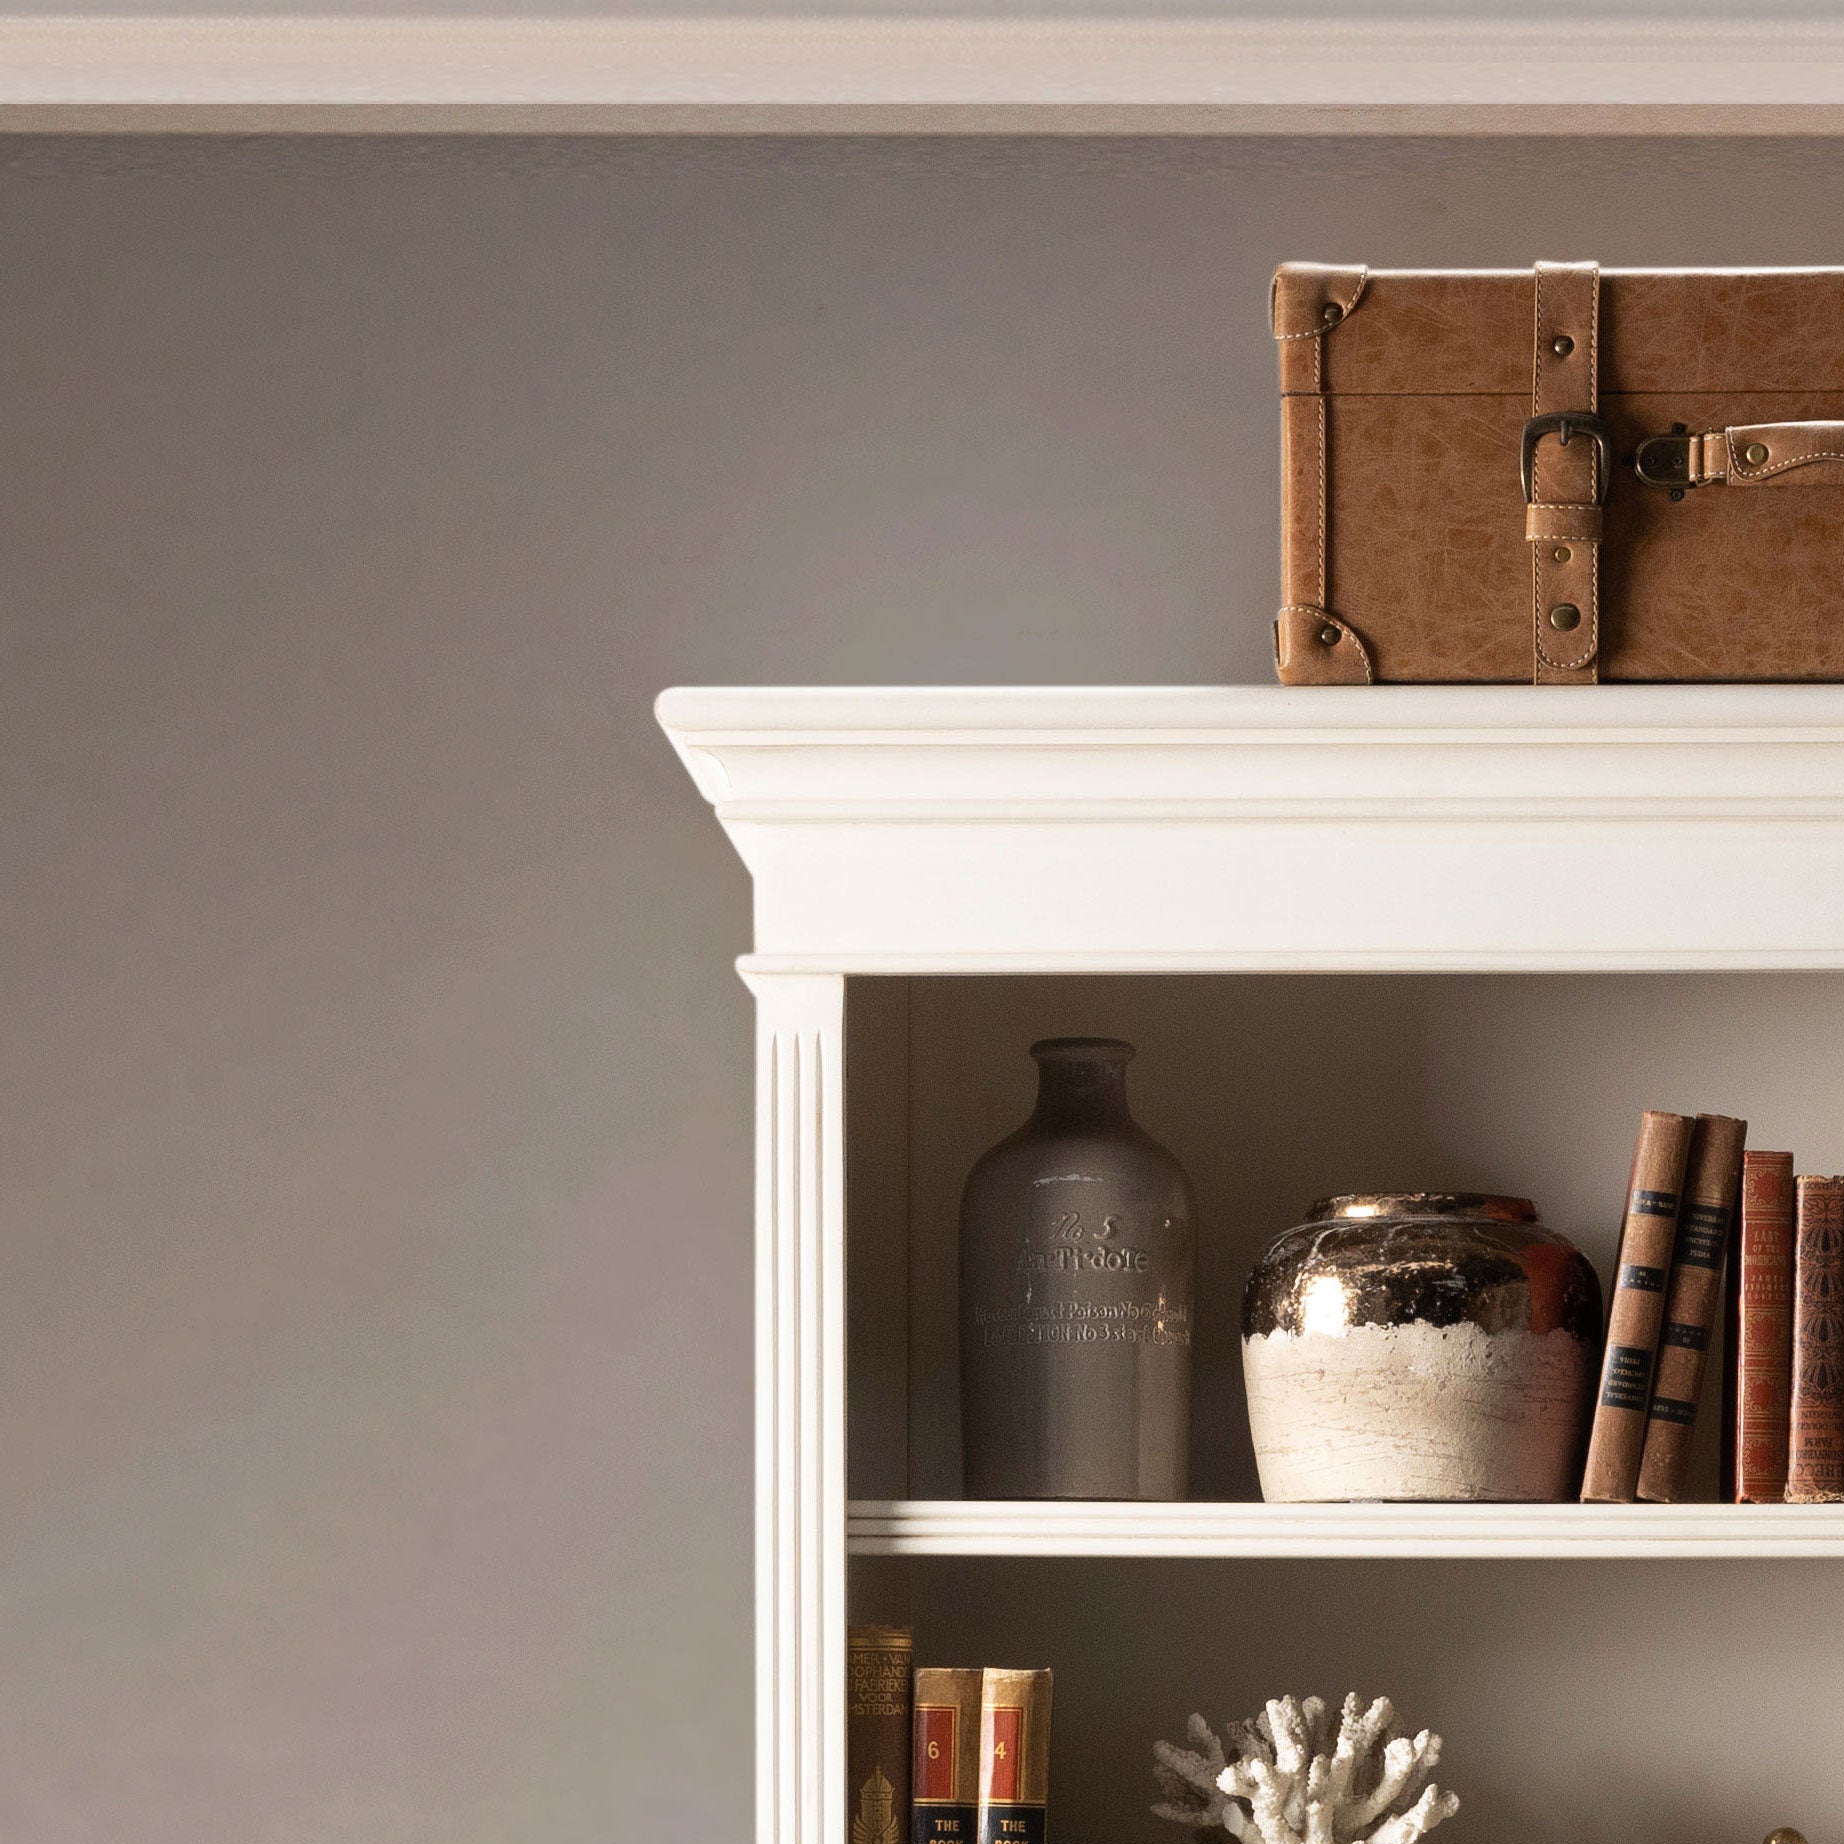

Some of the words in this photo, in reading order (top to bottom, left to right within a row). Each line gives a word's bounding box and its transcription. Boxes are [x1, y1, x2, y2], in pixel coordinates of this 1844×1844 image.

[928, 1741, 940, 1759] 6
[995, 1741, 1007, 1760] 4
[934, 1820, 960, 1832] THE
[1000, 1820, 1026, 1833] THE
